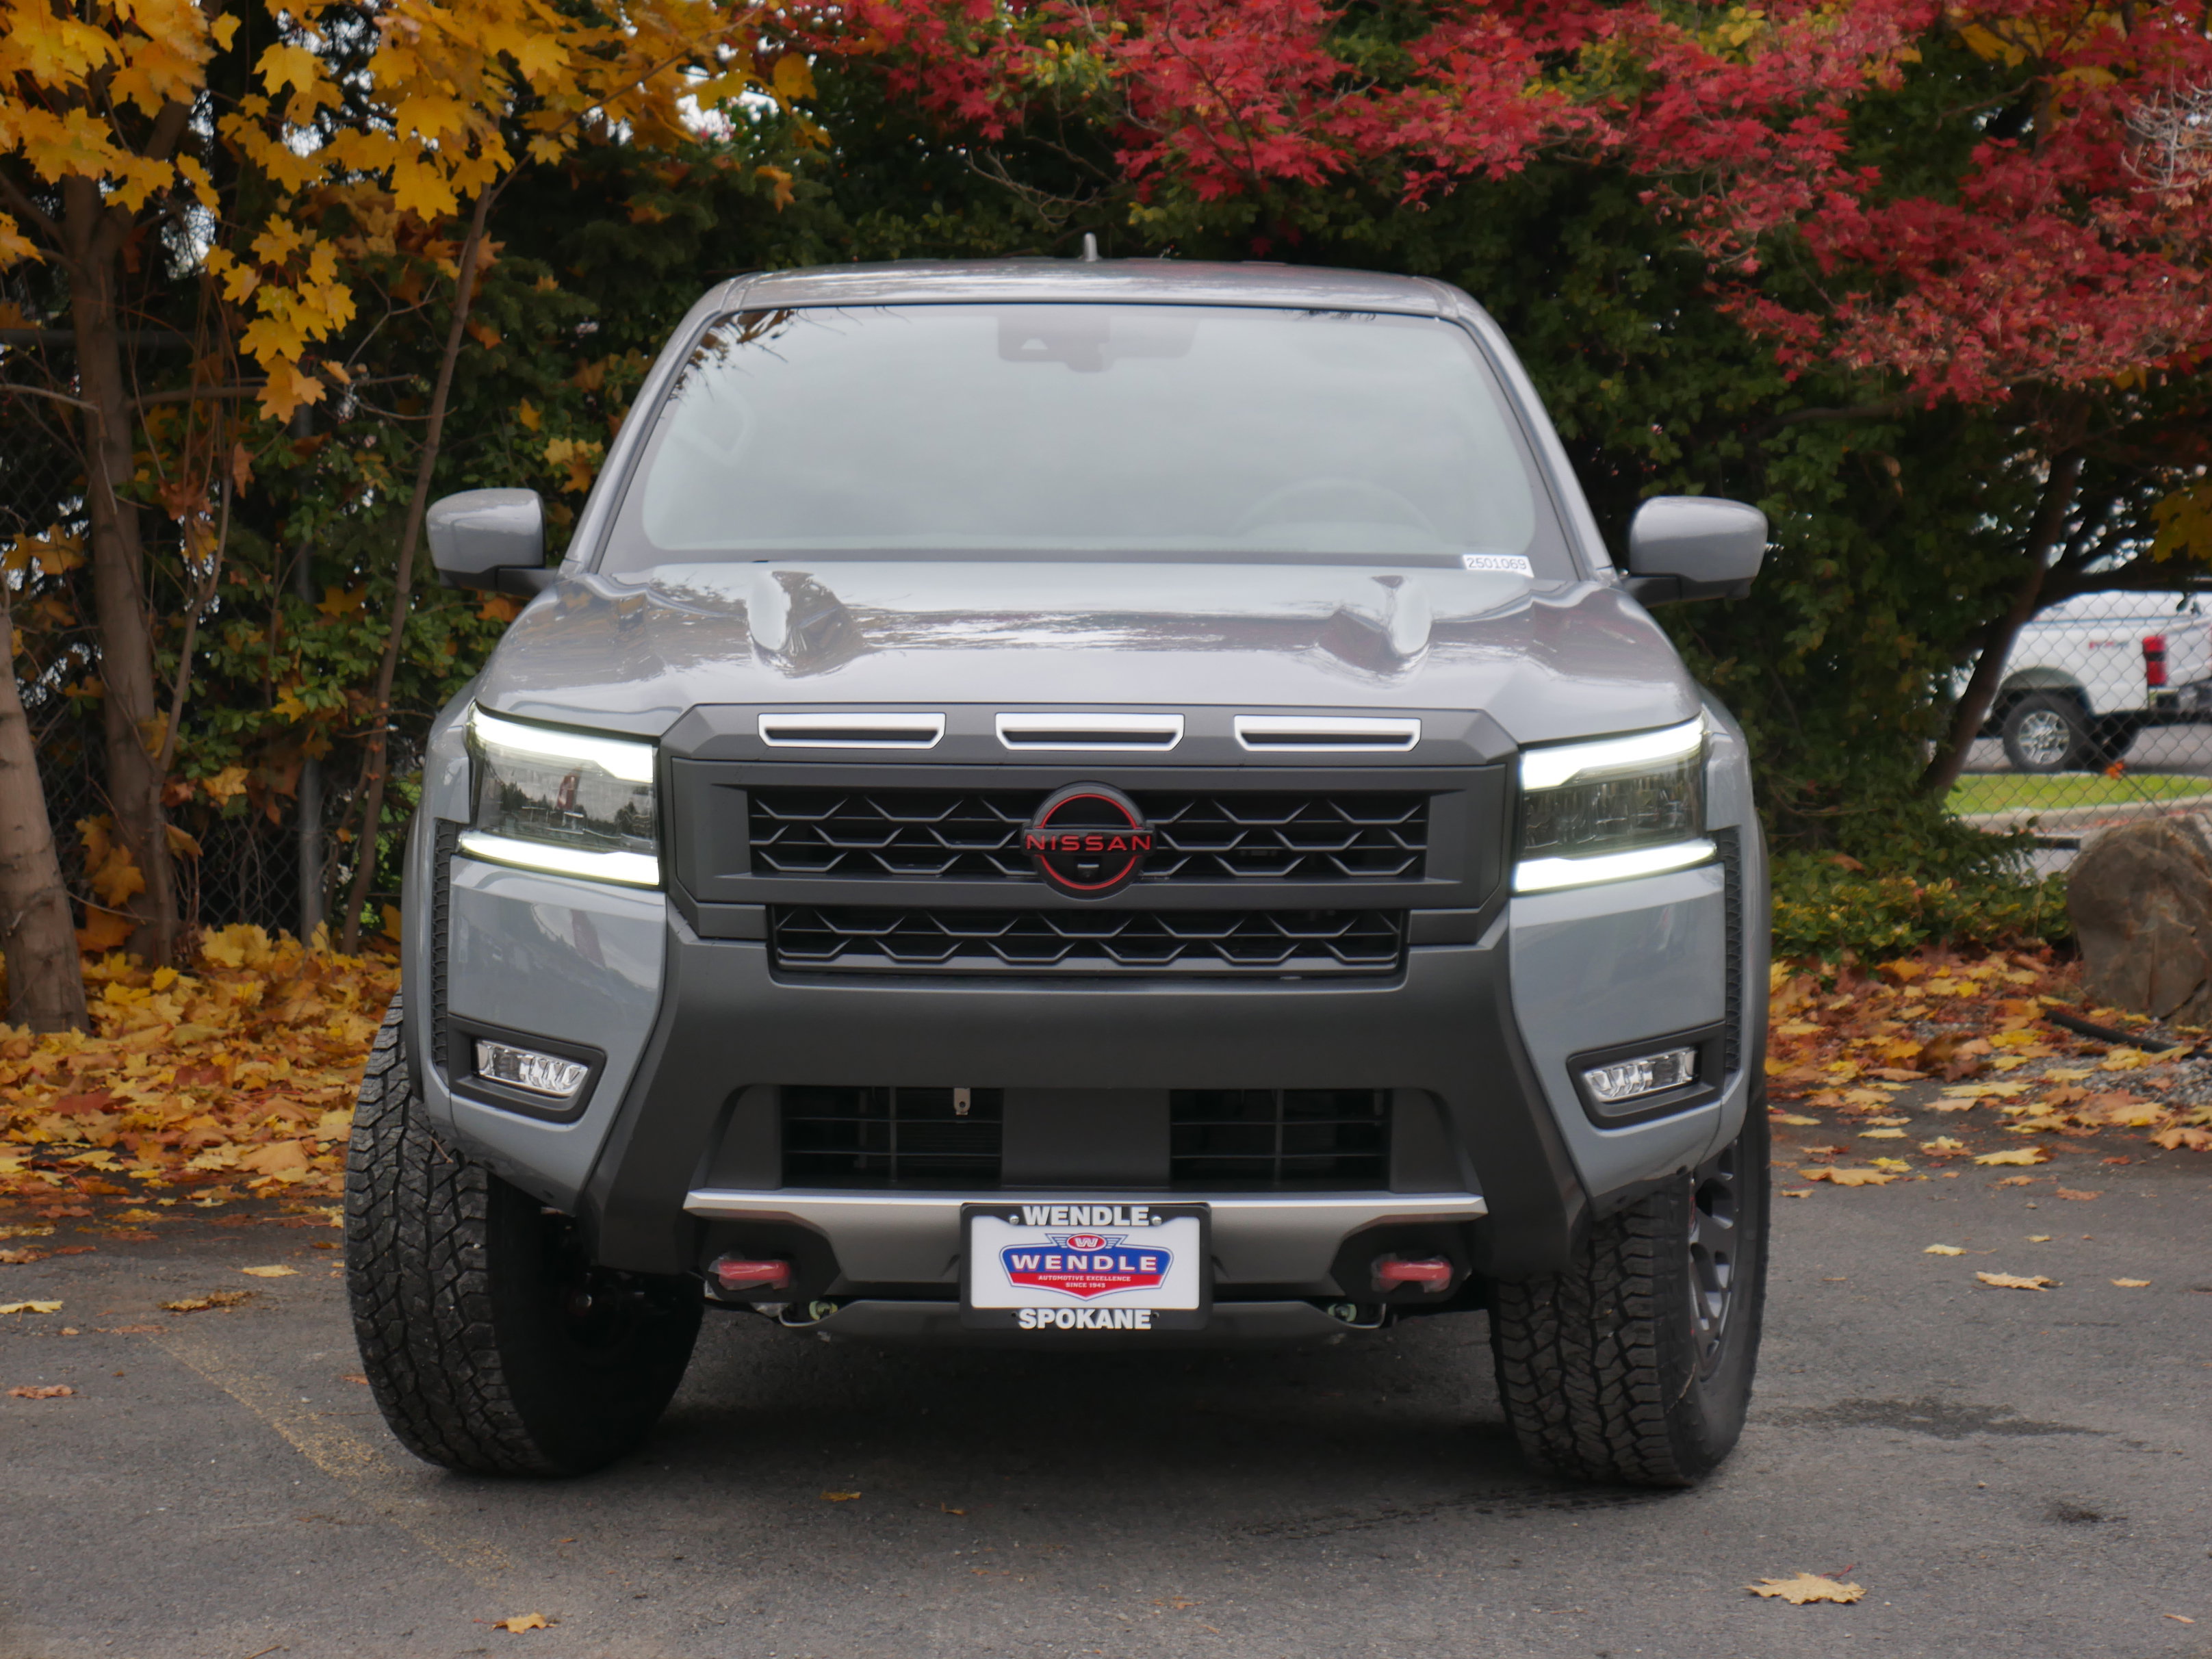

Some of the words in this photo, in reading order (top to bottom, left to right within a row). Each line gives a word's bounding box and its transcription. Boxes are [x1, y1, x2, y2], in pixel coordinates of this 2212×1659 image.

[1467, 558, 1527, 569] 2501069
[1025, 835, 1151, 851] NISSAN
[1023, 1206, 1150, 1226] WENDLE
[1075, 1237, 1098, 1248] W
[1012, 1255, 1157, 1271] WENDLE
[1018, 1309, 1152, 1330] SPOKANE
